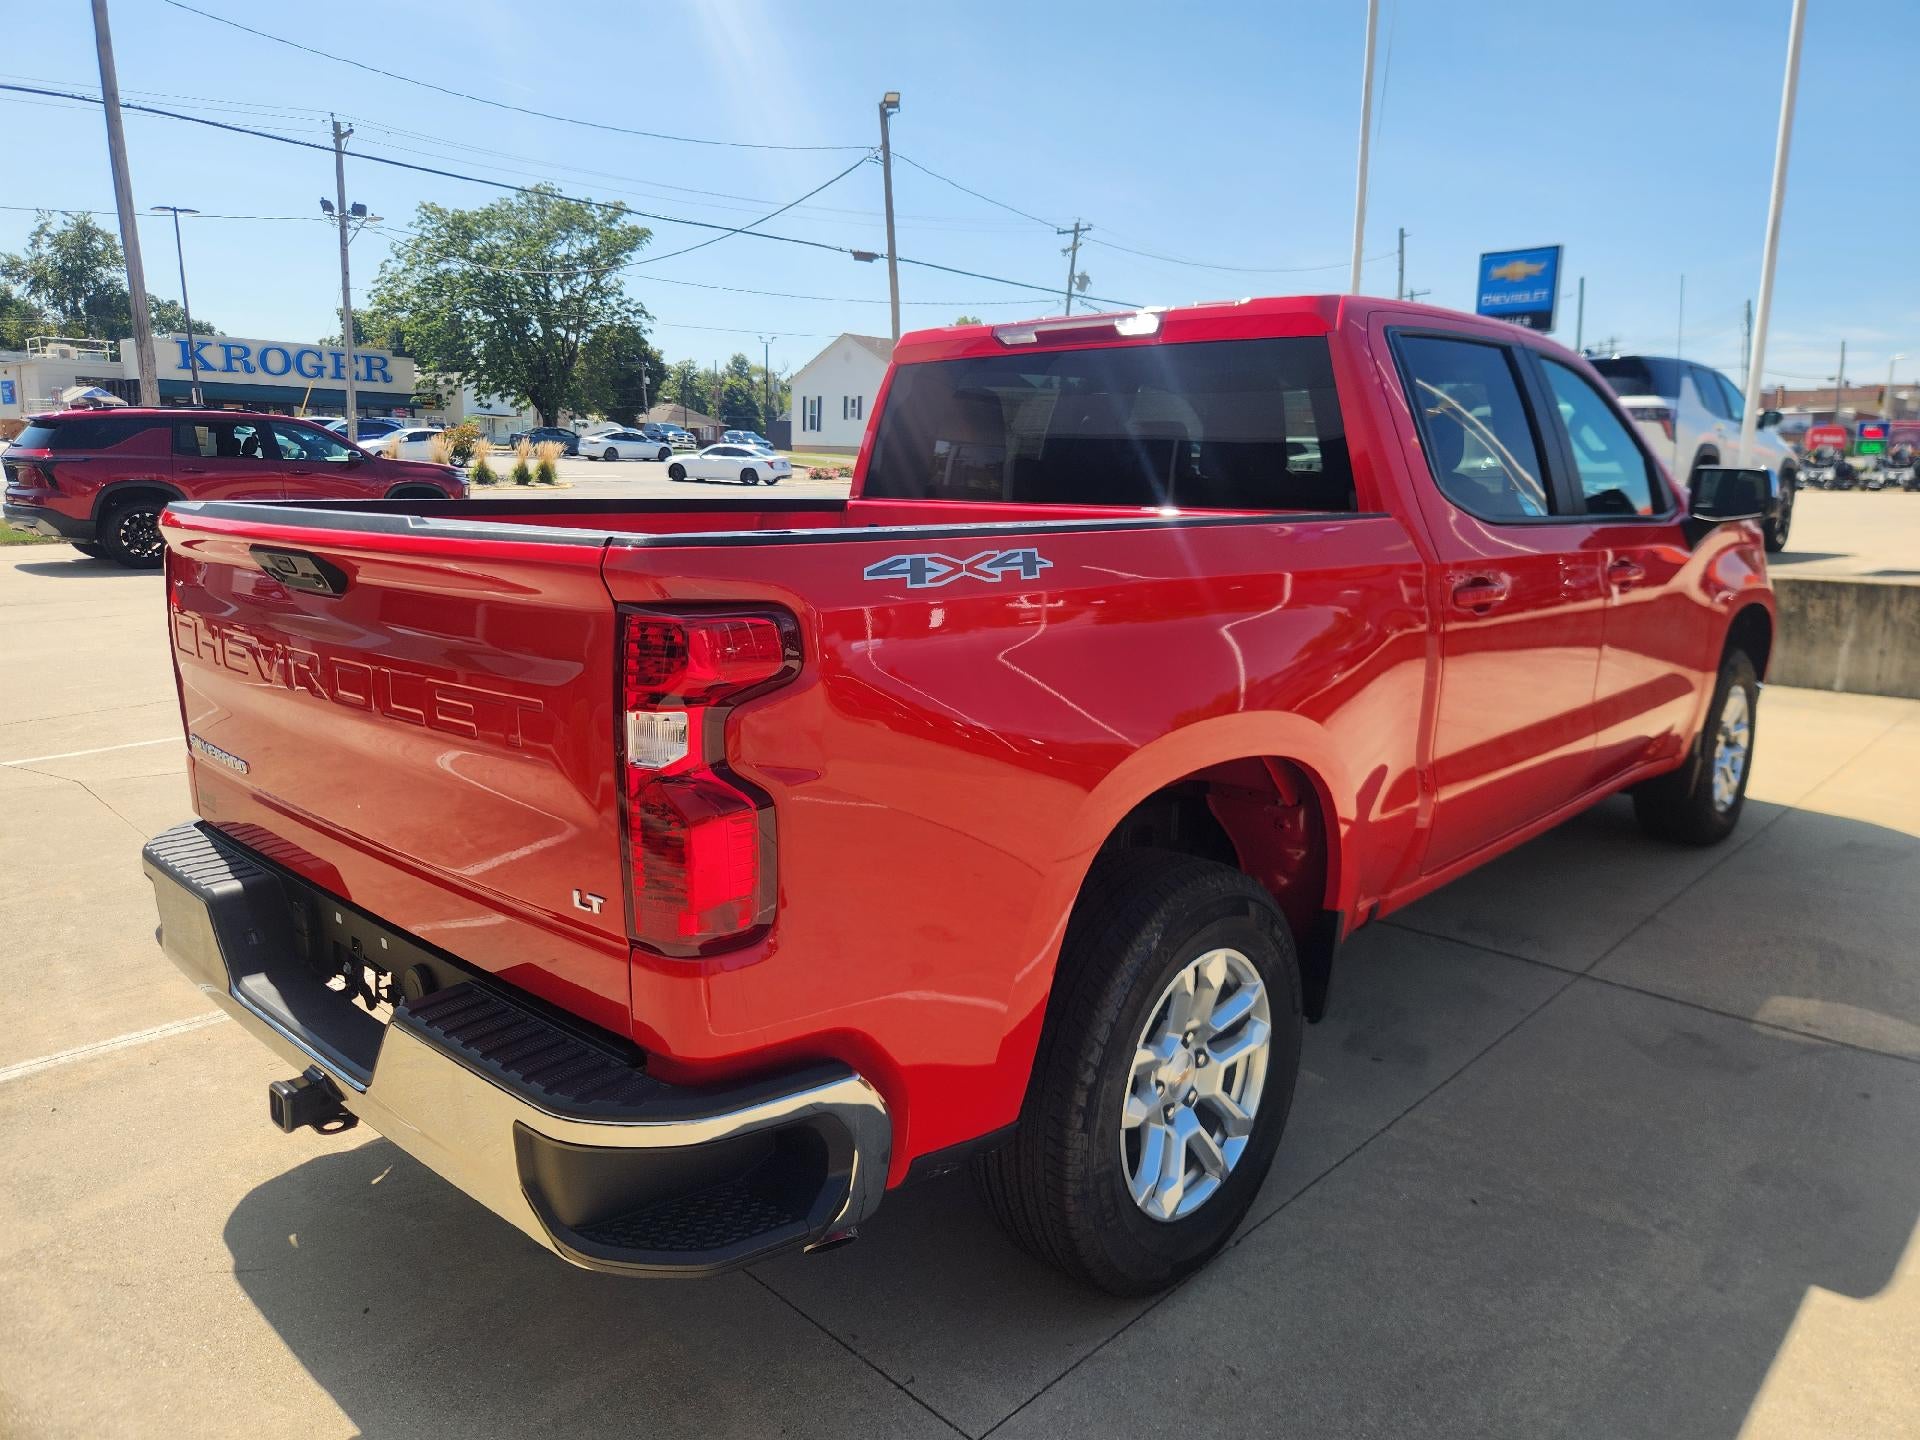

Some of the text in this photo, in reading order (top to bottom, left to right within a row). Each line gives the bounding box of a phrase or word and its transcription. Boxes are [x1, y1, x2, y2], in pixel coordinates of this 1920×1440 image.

[175, 339, 393, 383] KROGER
[174, 612, 544, 748] CHEVROLET
[573, 889, 607, 914] LT
